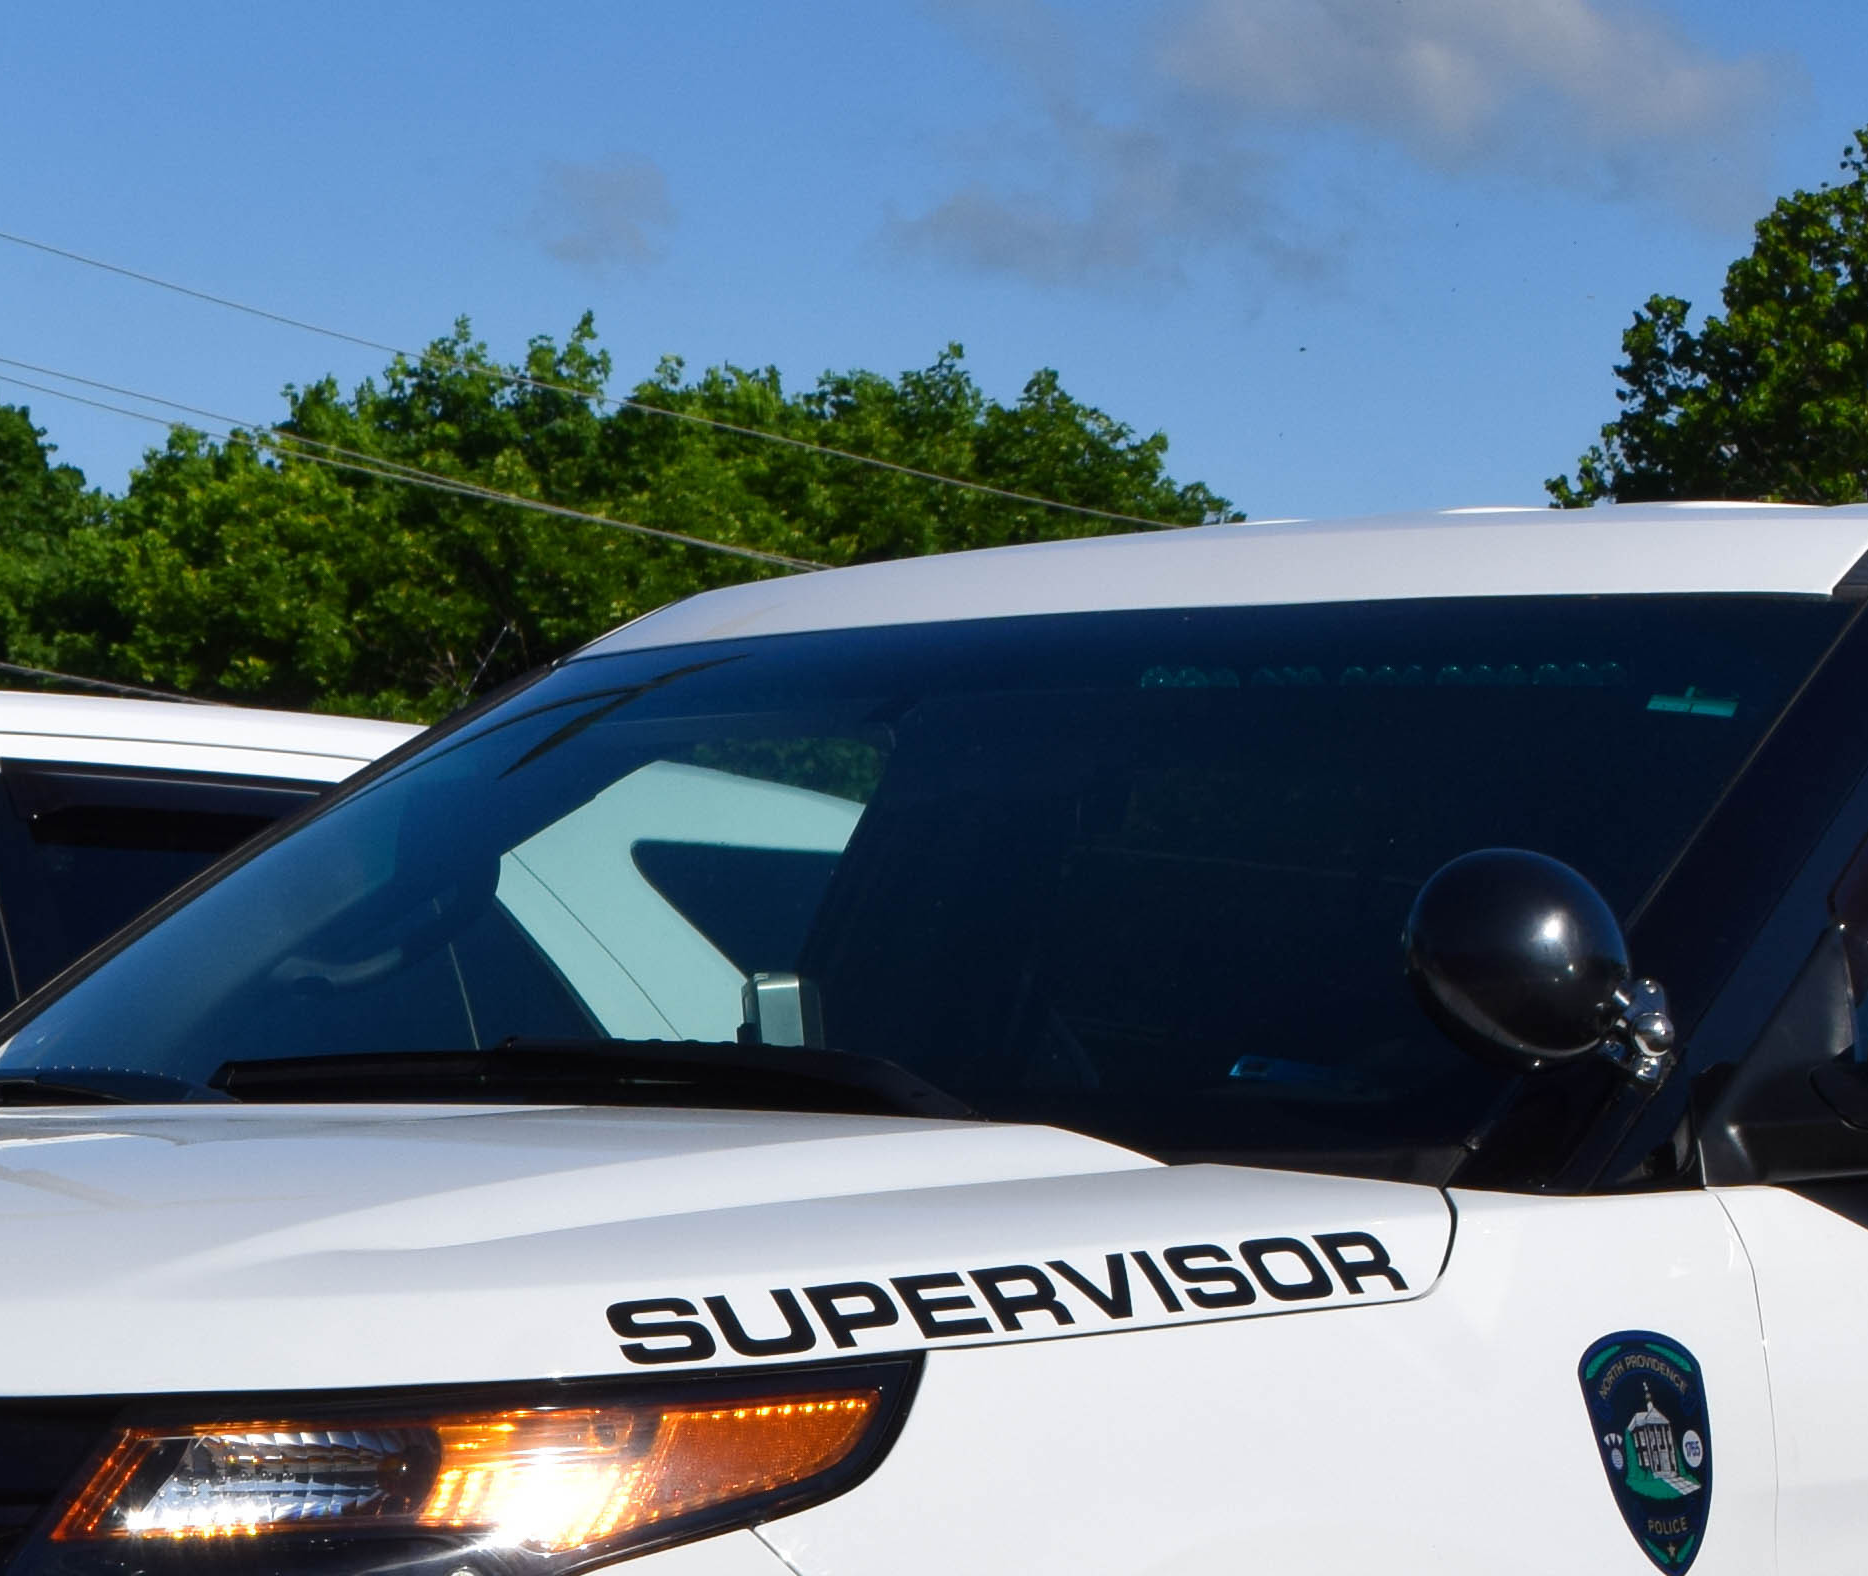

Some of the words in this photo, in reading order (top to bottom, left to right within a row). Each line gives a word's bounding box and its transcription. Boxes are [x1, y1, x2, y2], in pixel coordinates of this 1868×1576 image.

[606, 1232, 1408, 1364] SUPERVISOR
[1597, 1360, 1624, 1399] NORTH
[1647, 1515, 1687, 1536] POLICE
